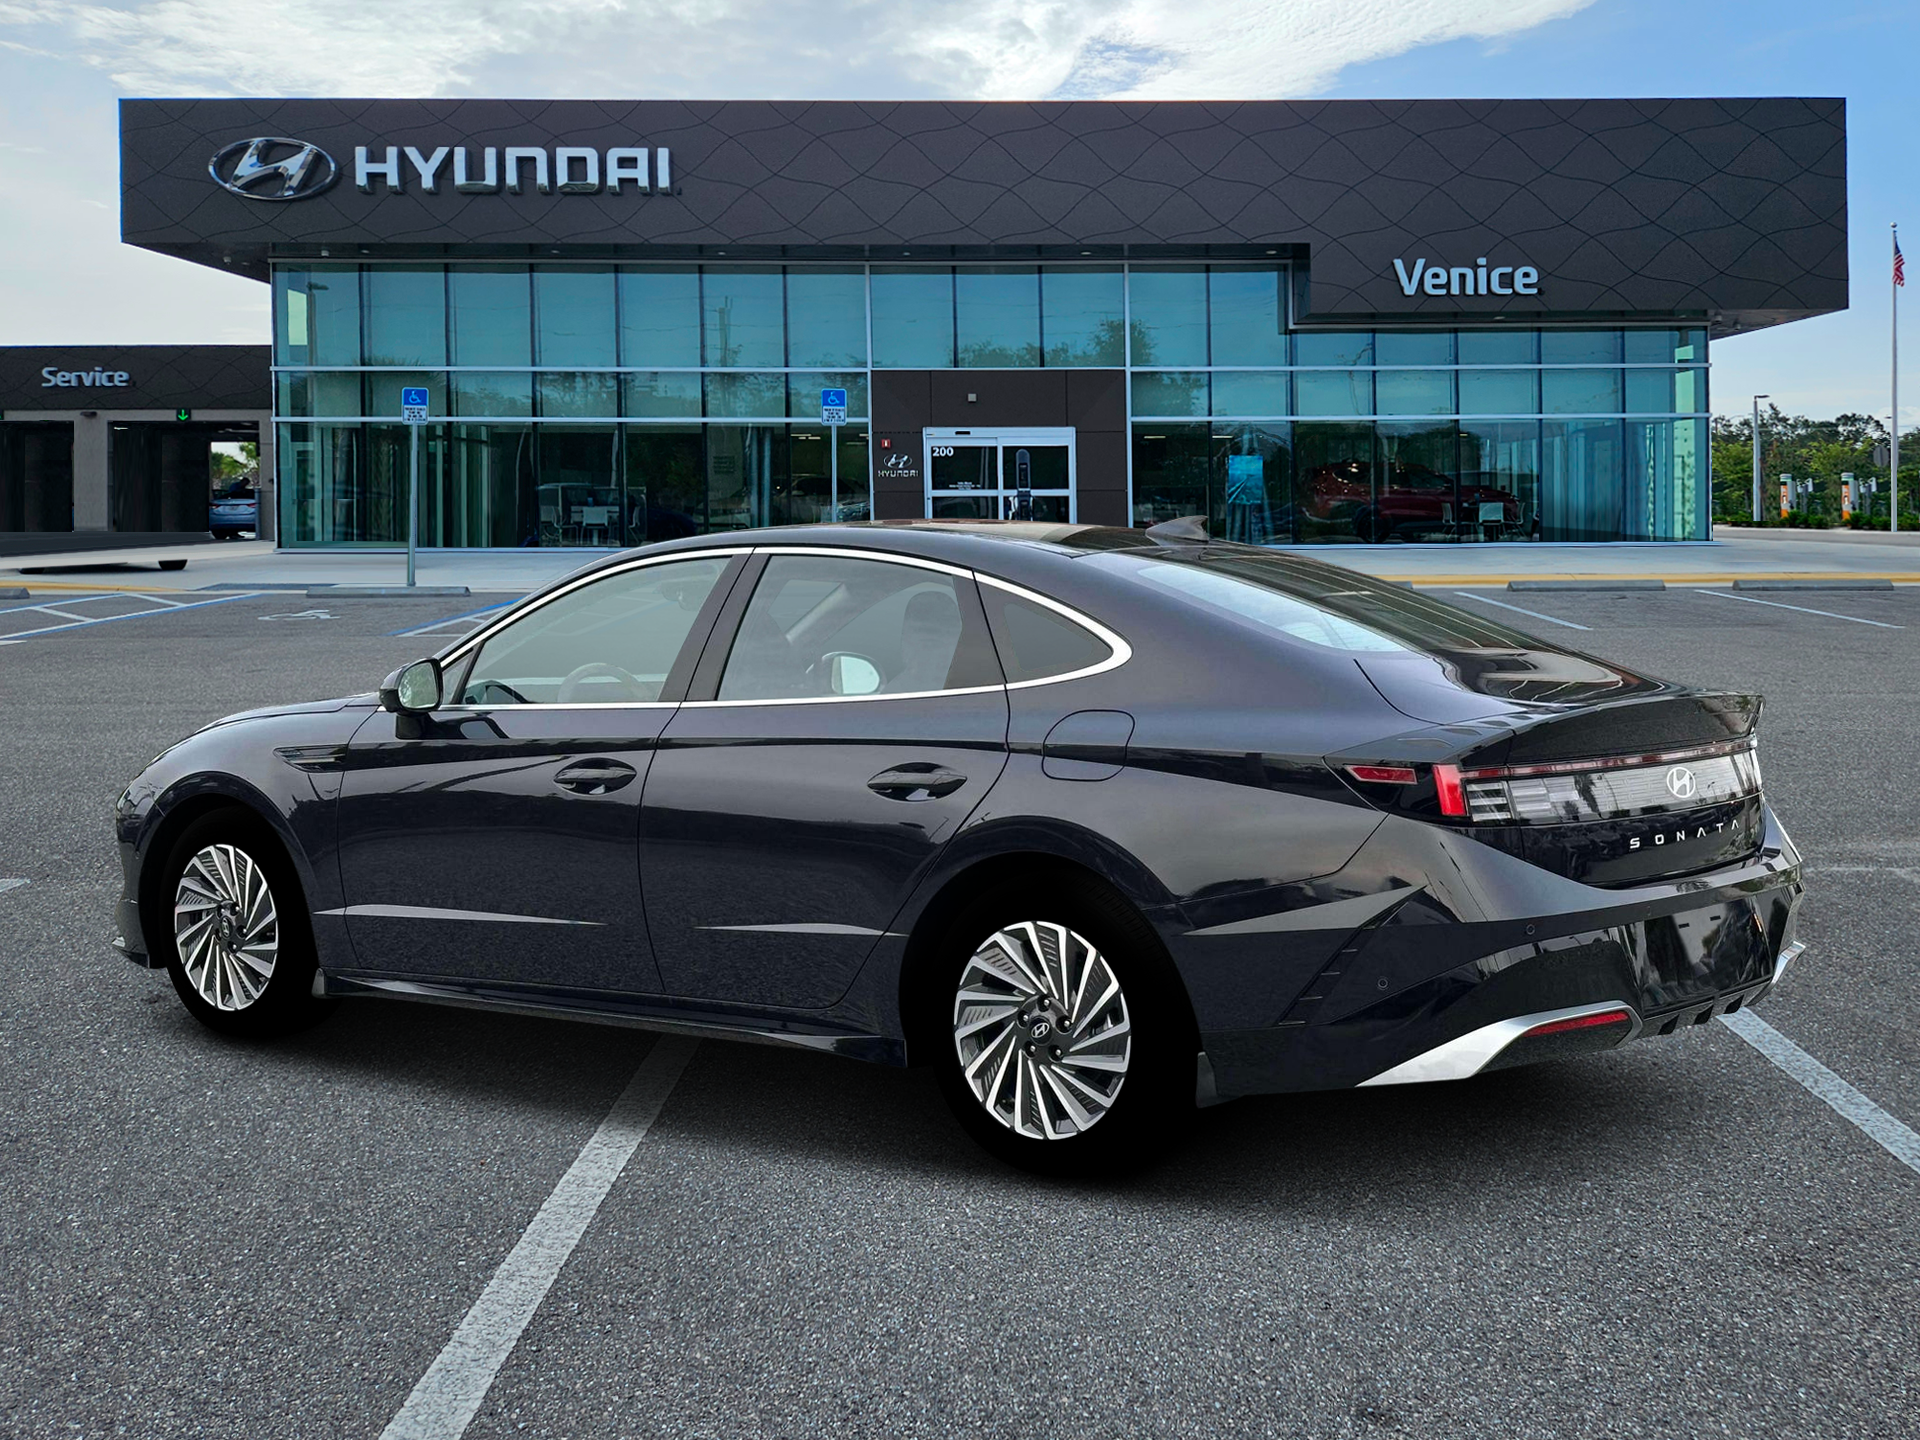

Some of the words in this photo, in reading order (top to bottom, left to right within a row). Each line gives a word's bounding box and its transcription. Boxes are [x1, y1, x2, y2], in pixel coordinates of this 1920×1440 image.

[354, 146, 671, 194] HYUNDAI
[1392, 256, 1539, 296] Venice
[41, 366, 130, 387] Service
[932, 446, 955, 457] 200
[877, 469, 919, 478] HYUNDAI
[1629, 819, 1740, 849] SONATA
